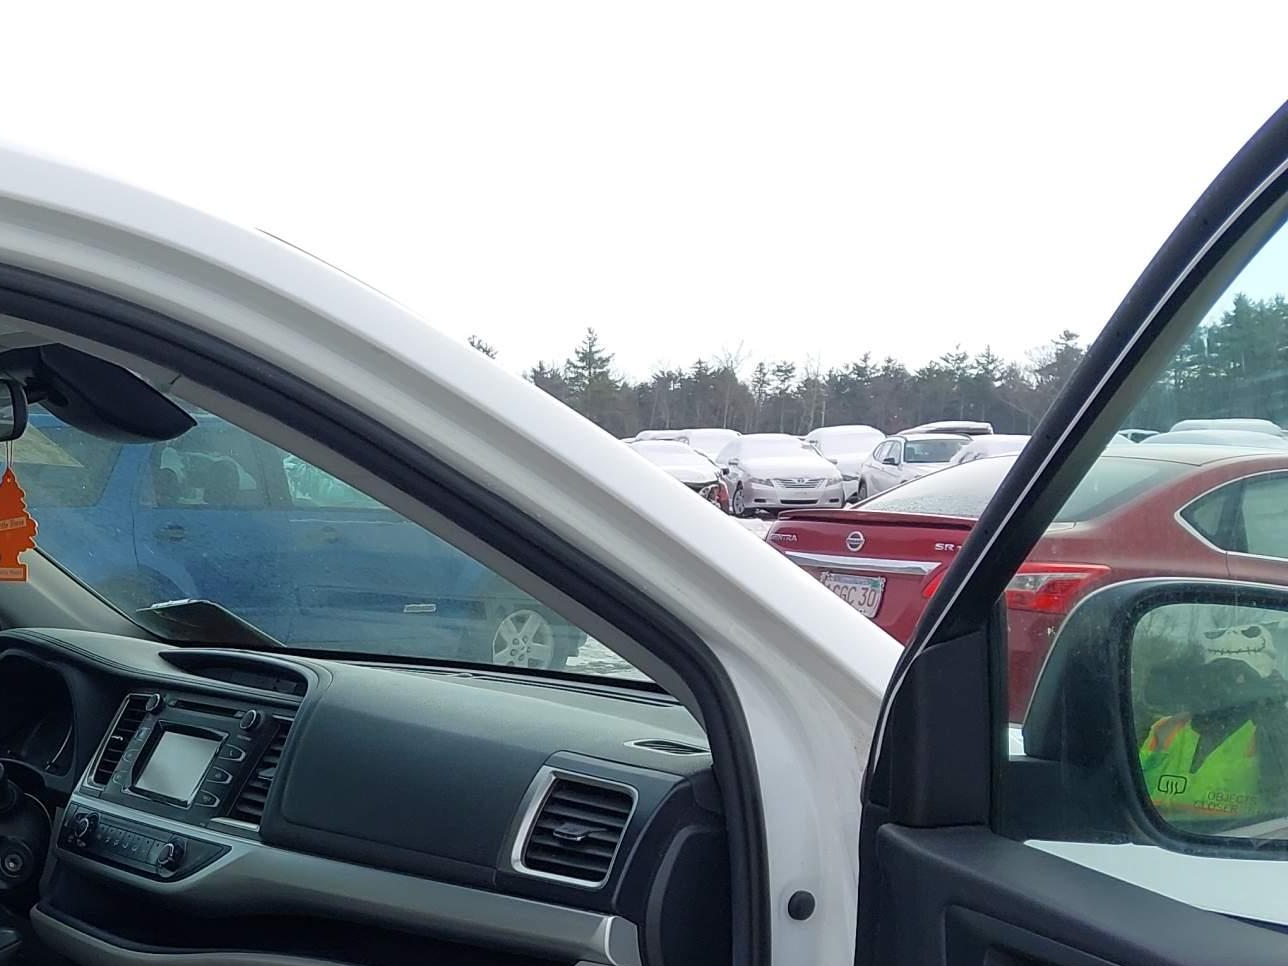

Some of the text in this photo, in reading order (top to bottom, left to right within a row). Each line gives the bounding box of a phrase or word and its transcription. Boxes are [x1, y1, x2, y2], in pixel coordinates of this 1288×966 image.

[935, 542, 955, 552] SR
[858, 587, 877, 608] 30
[1207, 791, 1258, 805] OBJECTS
